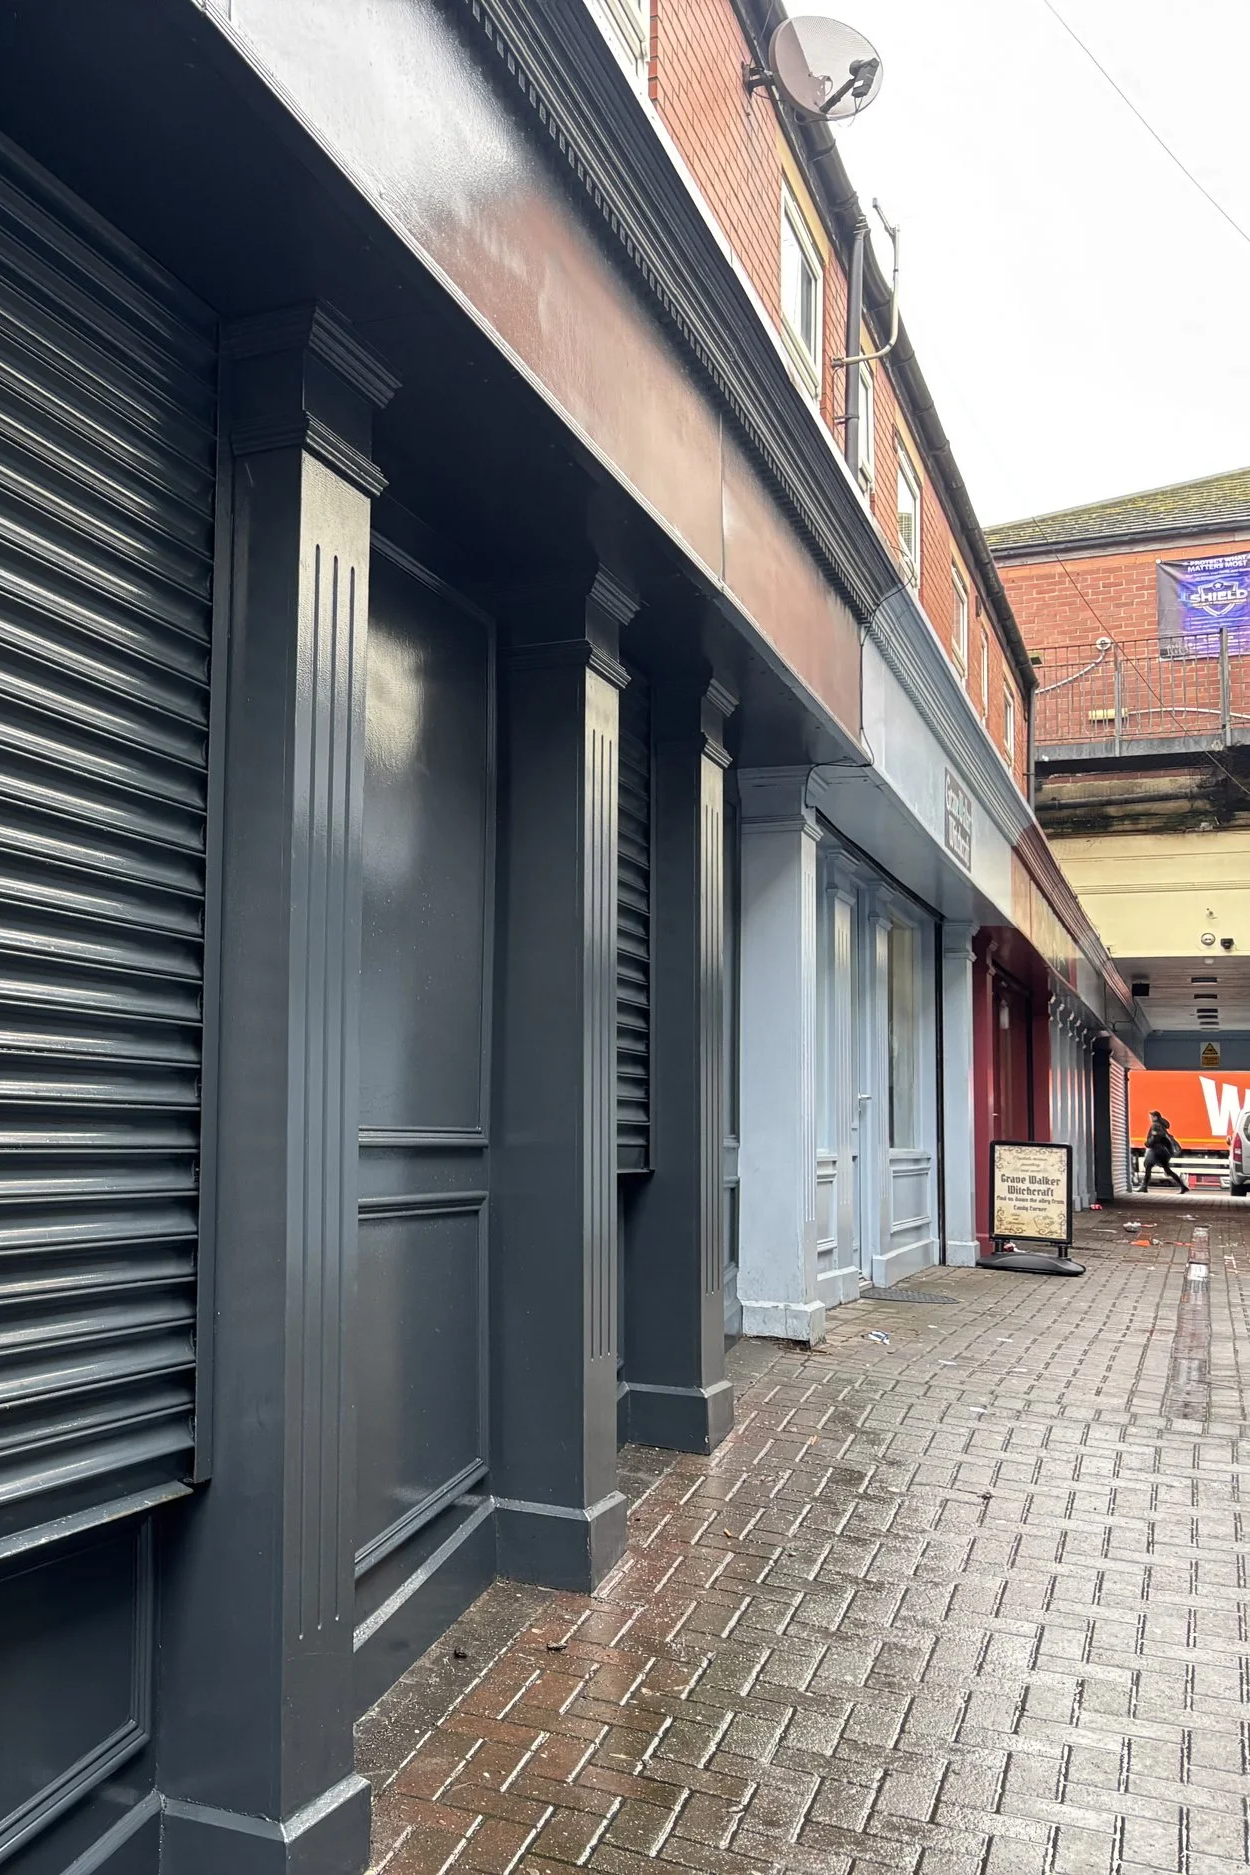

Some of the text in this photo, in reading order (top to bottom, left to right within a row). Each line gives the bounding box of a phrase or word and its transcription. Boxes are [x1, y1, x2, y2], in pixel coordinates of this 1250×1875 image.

[1189, 554, 1247, 566] PROTECT WHAT
[1187, 563, 1224, 573] MATTERS
[1225, 560, 1248, 568] MOST
[1190, 590, 1249, 603] SHIELD
[1001, 1174, 1061, 1186] Grave Walker
[1007, 1185, 1054, 1197] Witchcraft
